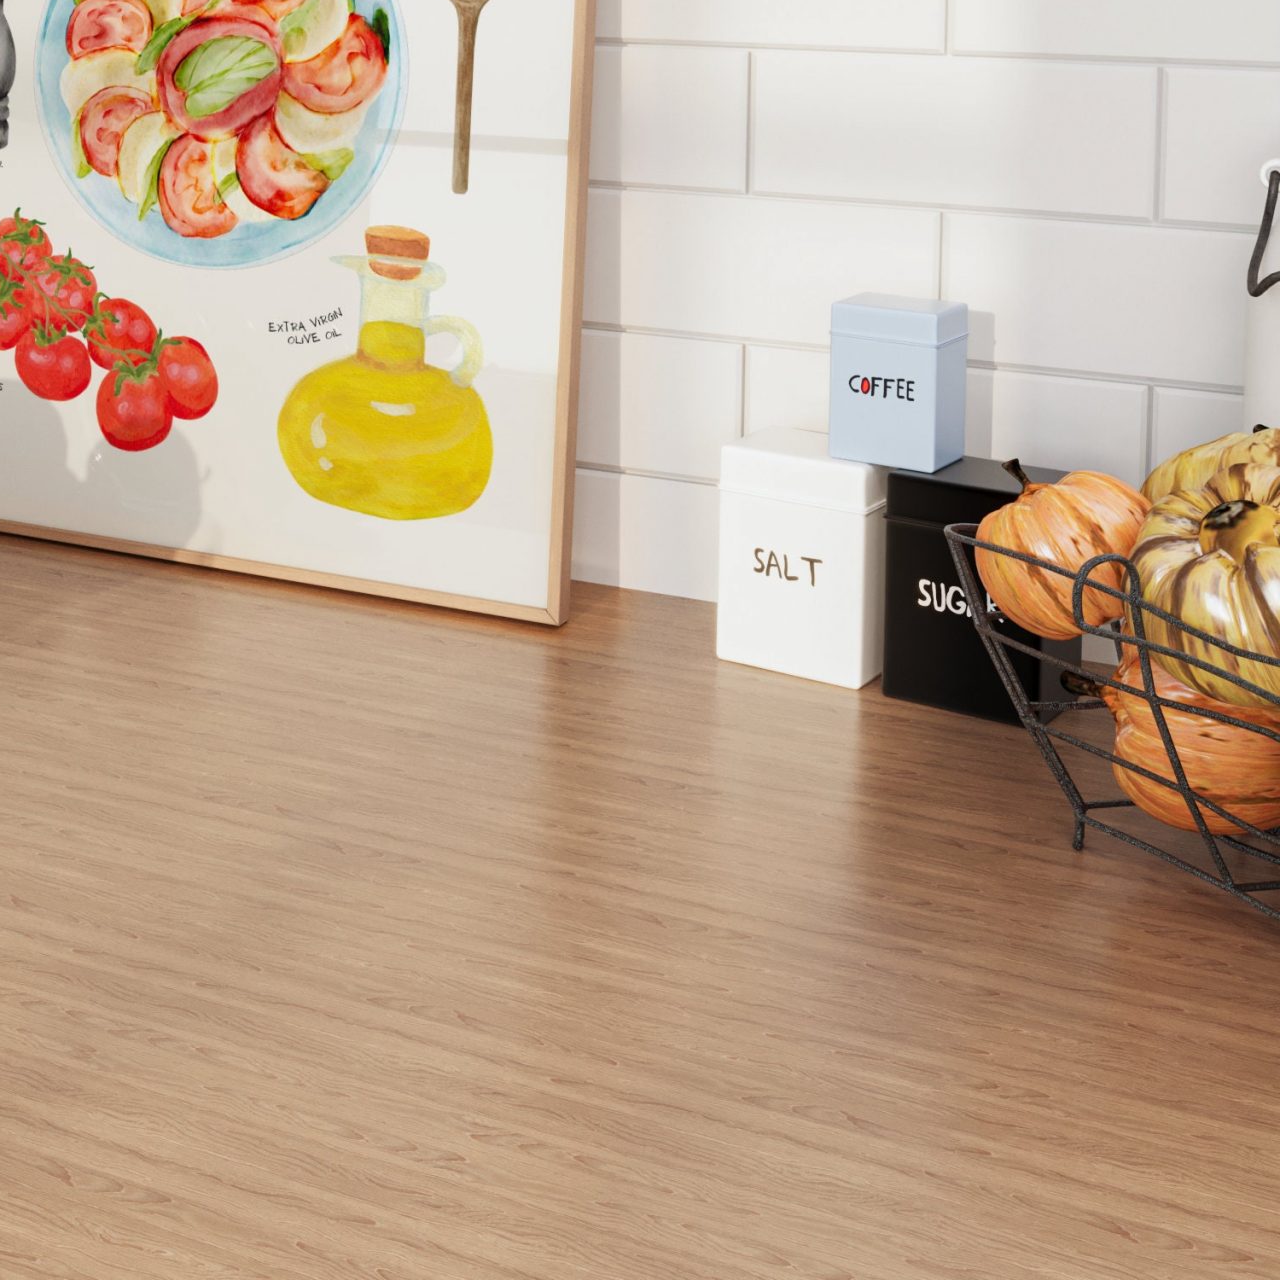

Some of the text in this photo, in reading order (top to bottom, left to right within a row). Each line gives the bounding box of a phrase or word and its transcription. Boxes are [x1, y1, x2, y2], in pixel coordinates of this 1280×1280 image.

[268, 321, 307, 332] EXTRA
[848, 374, 916, 402] COFFEE
[753, 547, 823, 587] SALT
[917, 578, 1005, 624] SUG
